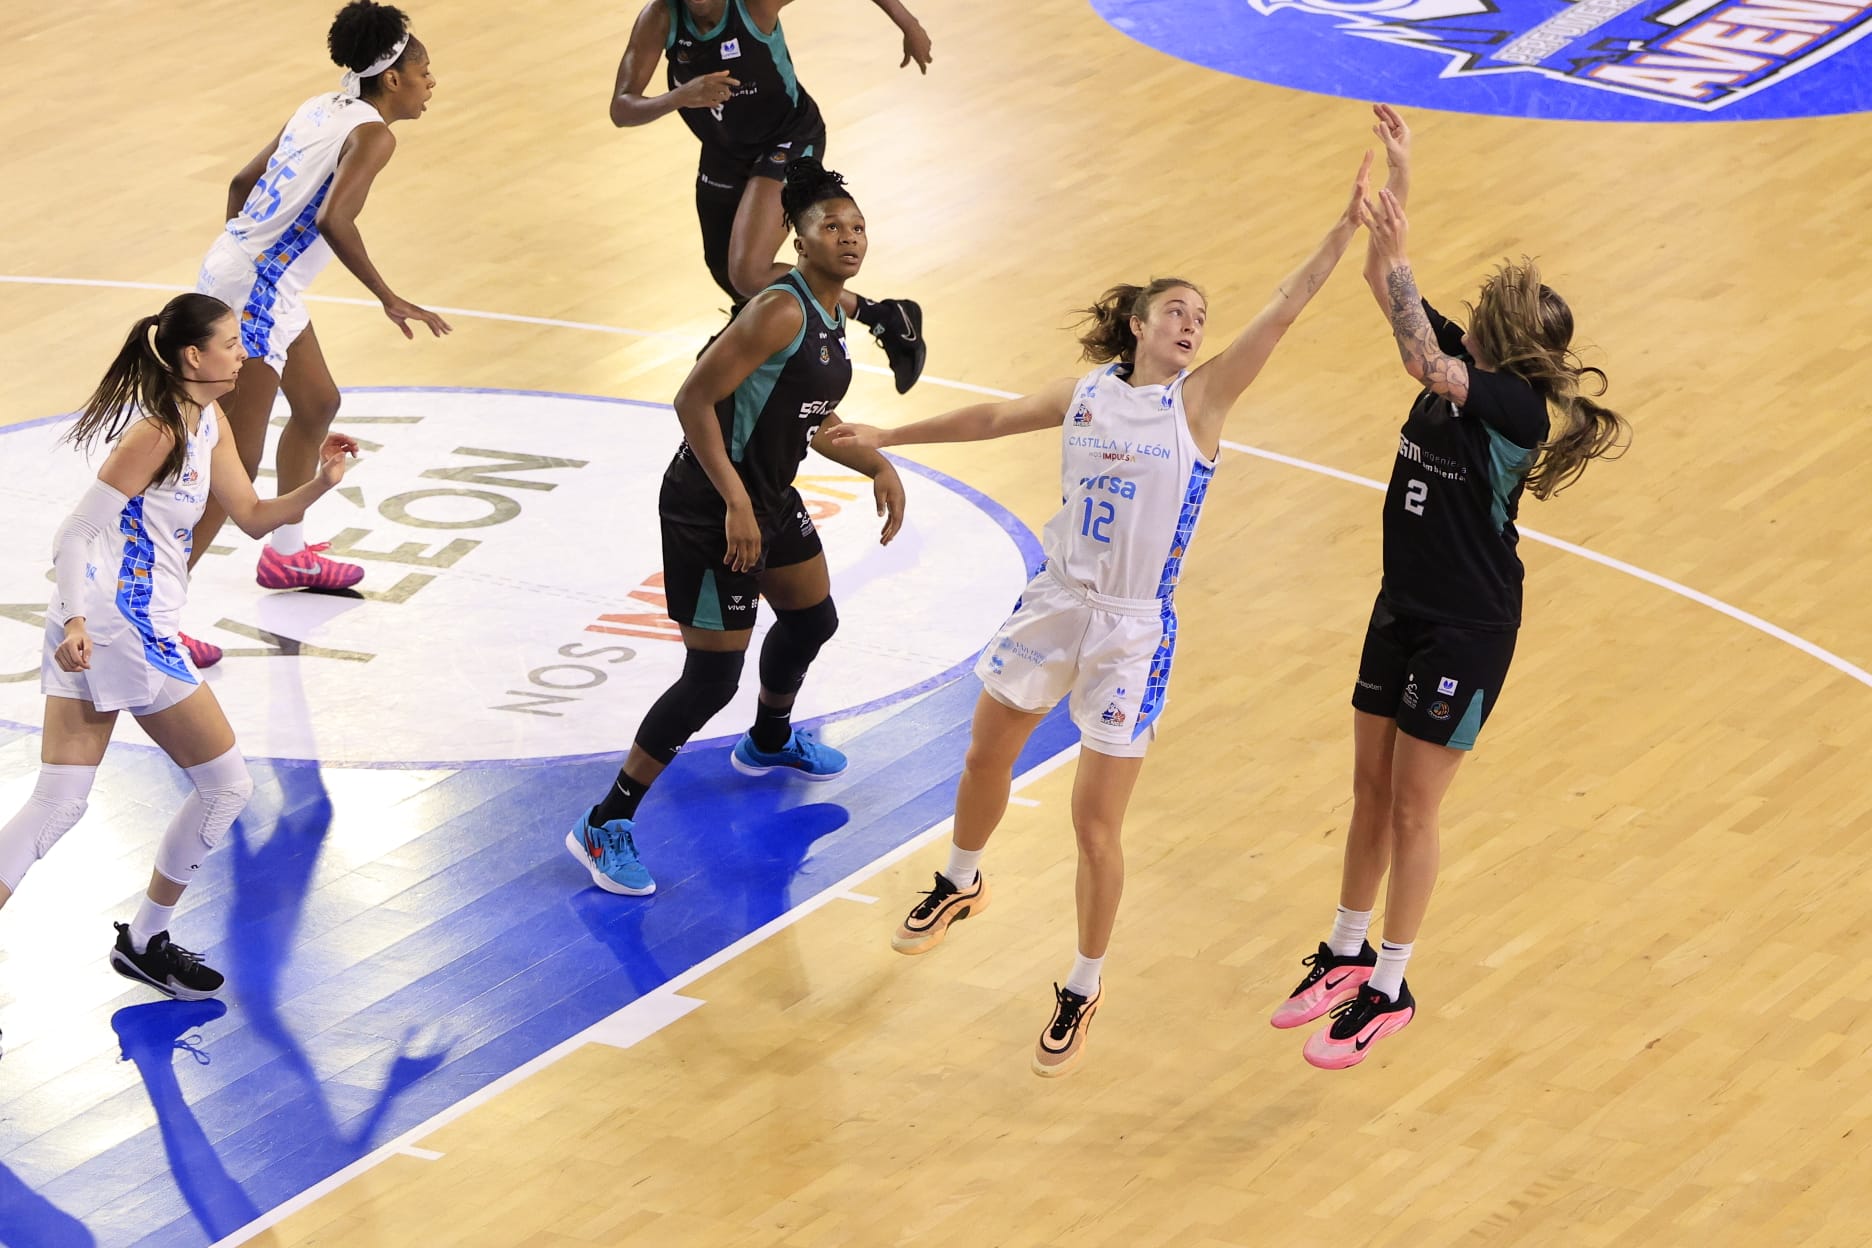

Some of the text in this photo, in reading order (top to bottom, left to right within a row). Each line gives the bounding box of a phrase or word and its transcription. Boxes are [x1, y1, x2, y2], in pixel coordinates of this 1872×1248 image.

[1588, 0, 1872, 98] AVEN
[1068, 436, 1171, 459] CASTILLA Y LEÓN
[1102, 452, 1136, 463] IMPULSA
[1404, 478, 1429, 516] 2
[1081, 496, 1116, 543] 12
[488, 642, 637, 718] NOS
